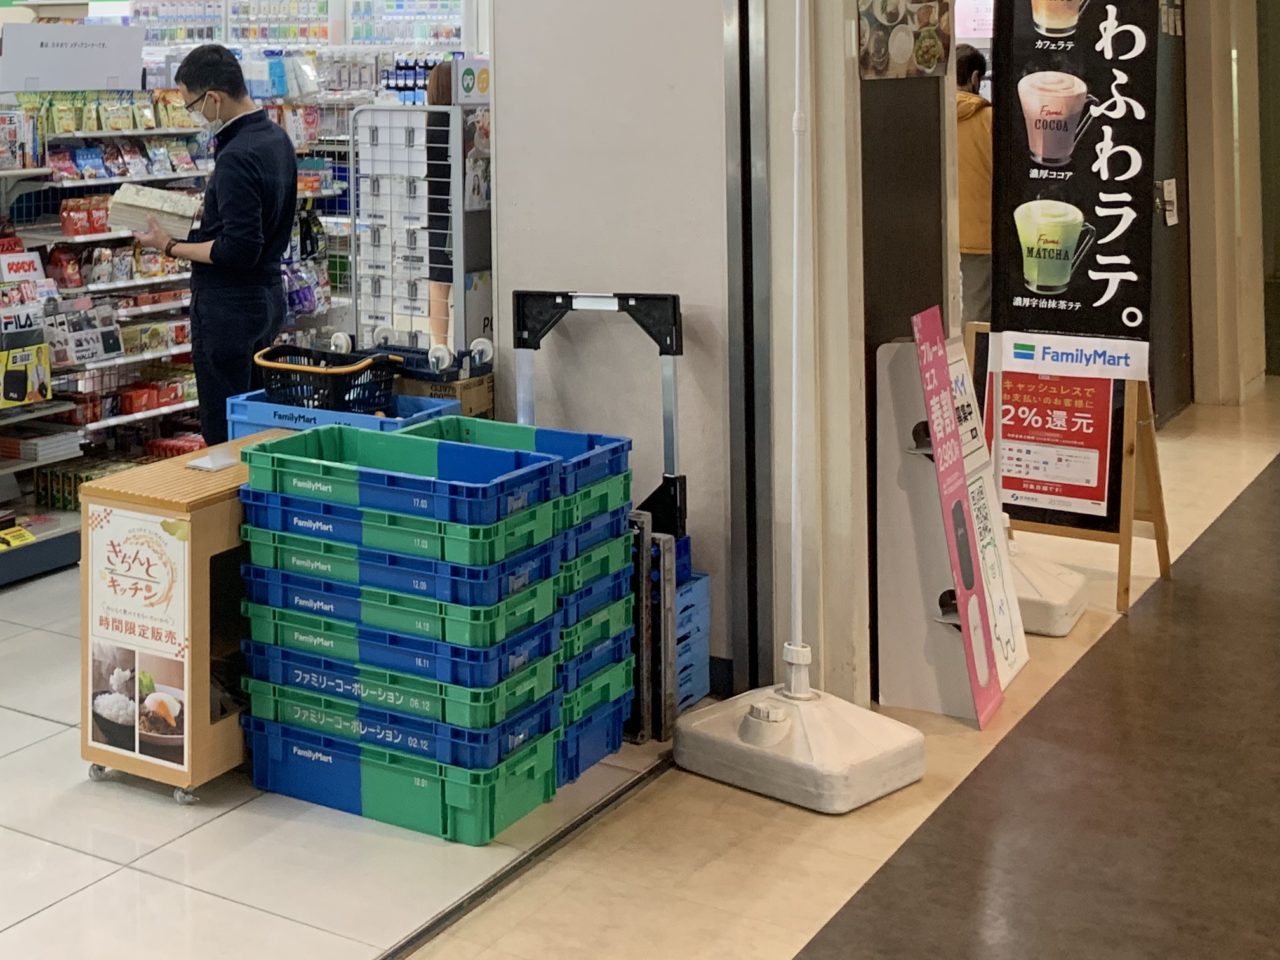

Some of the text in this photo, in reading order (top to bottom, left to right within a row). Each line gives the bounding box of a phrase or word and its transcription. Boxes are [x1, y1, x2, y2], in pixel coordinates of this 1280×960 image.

[1034, 39, 1075, 51] カフェラテ
[1034, 119, 1069, 132] COCOA
[1026, 246, 1070, 261] MATCHA
[2, 313, 33, 331] FILA
[1041, 346, 1131, 367] FamilyMart
[1003, 379, 1096, 397] キャッシュレスで
[273, 411, 317, 425] FamilyMart
[292, 478, 332, 493] FamilyMart
[293, 517, 333, 532] FamilyMart
[292, 556, 332, 572] FamilyMart
[295, 596, 334, 612] FamilyMart
[98, 615, 177, 645] 時間限定販売
[294, 632, 334, 648] FamilyMart
[294, 669, 404, 705] ファミリーコーポレーション
[293, 706, 403, 743] ファミリーコーポレーション
[293, 746, 333, 764] FamilyMart
